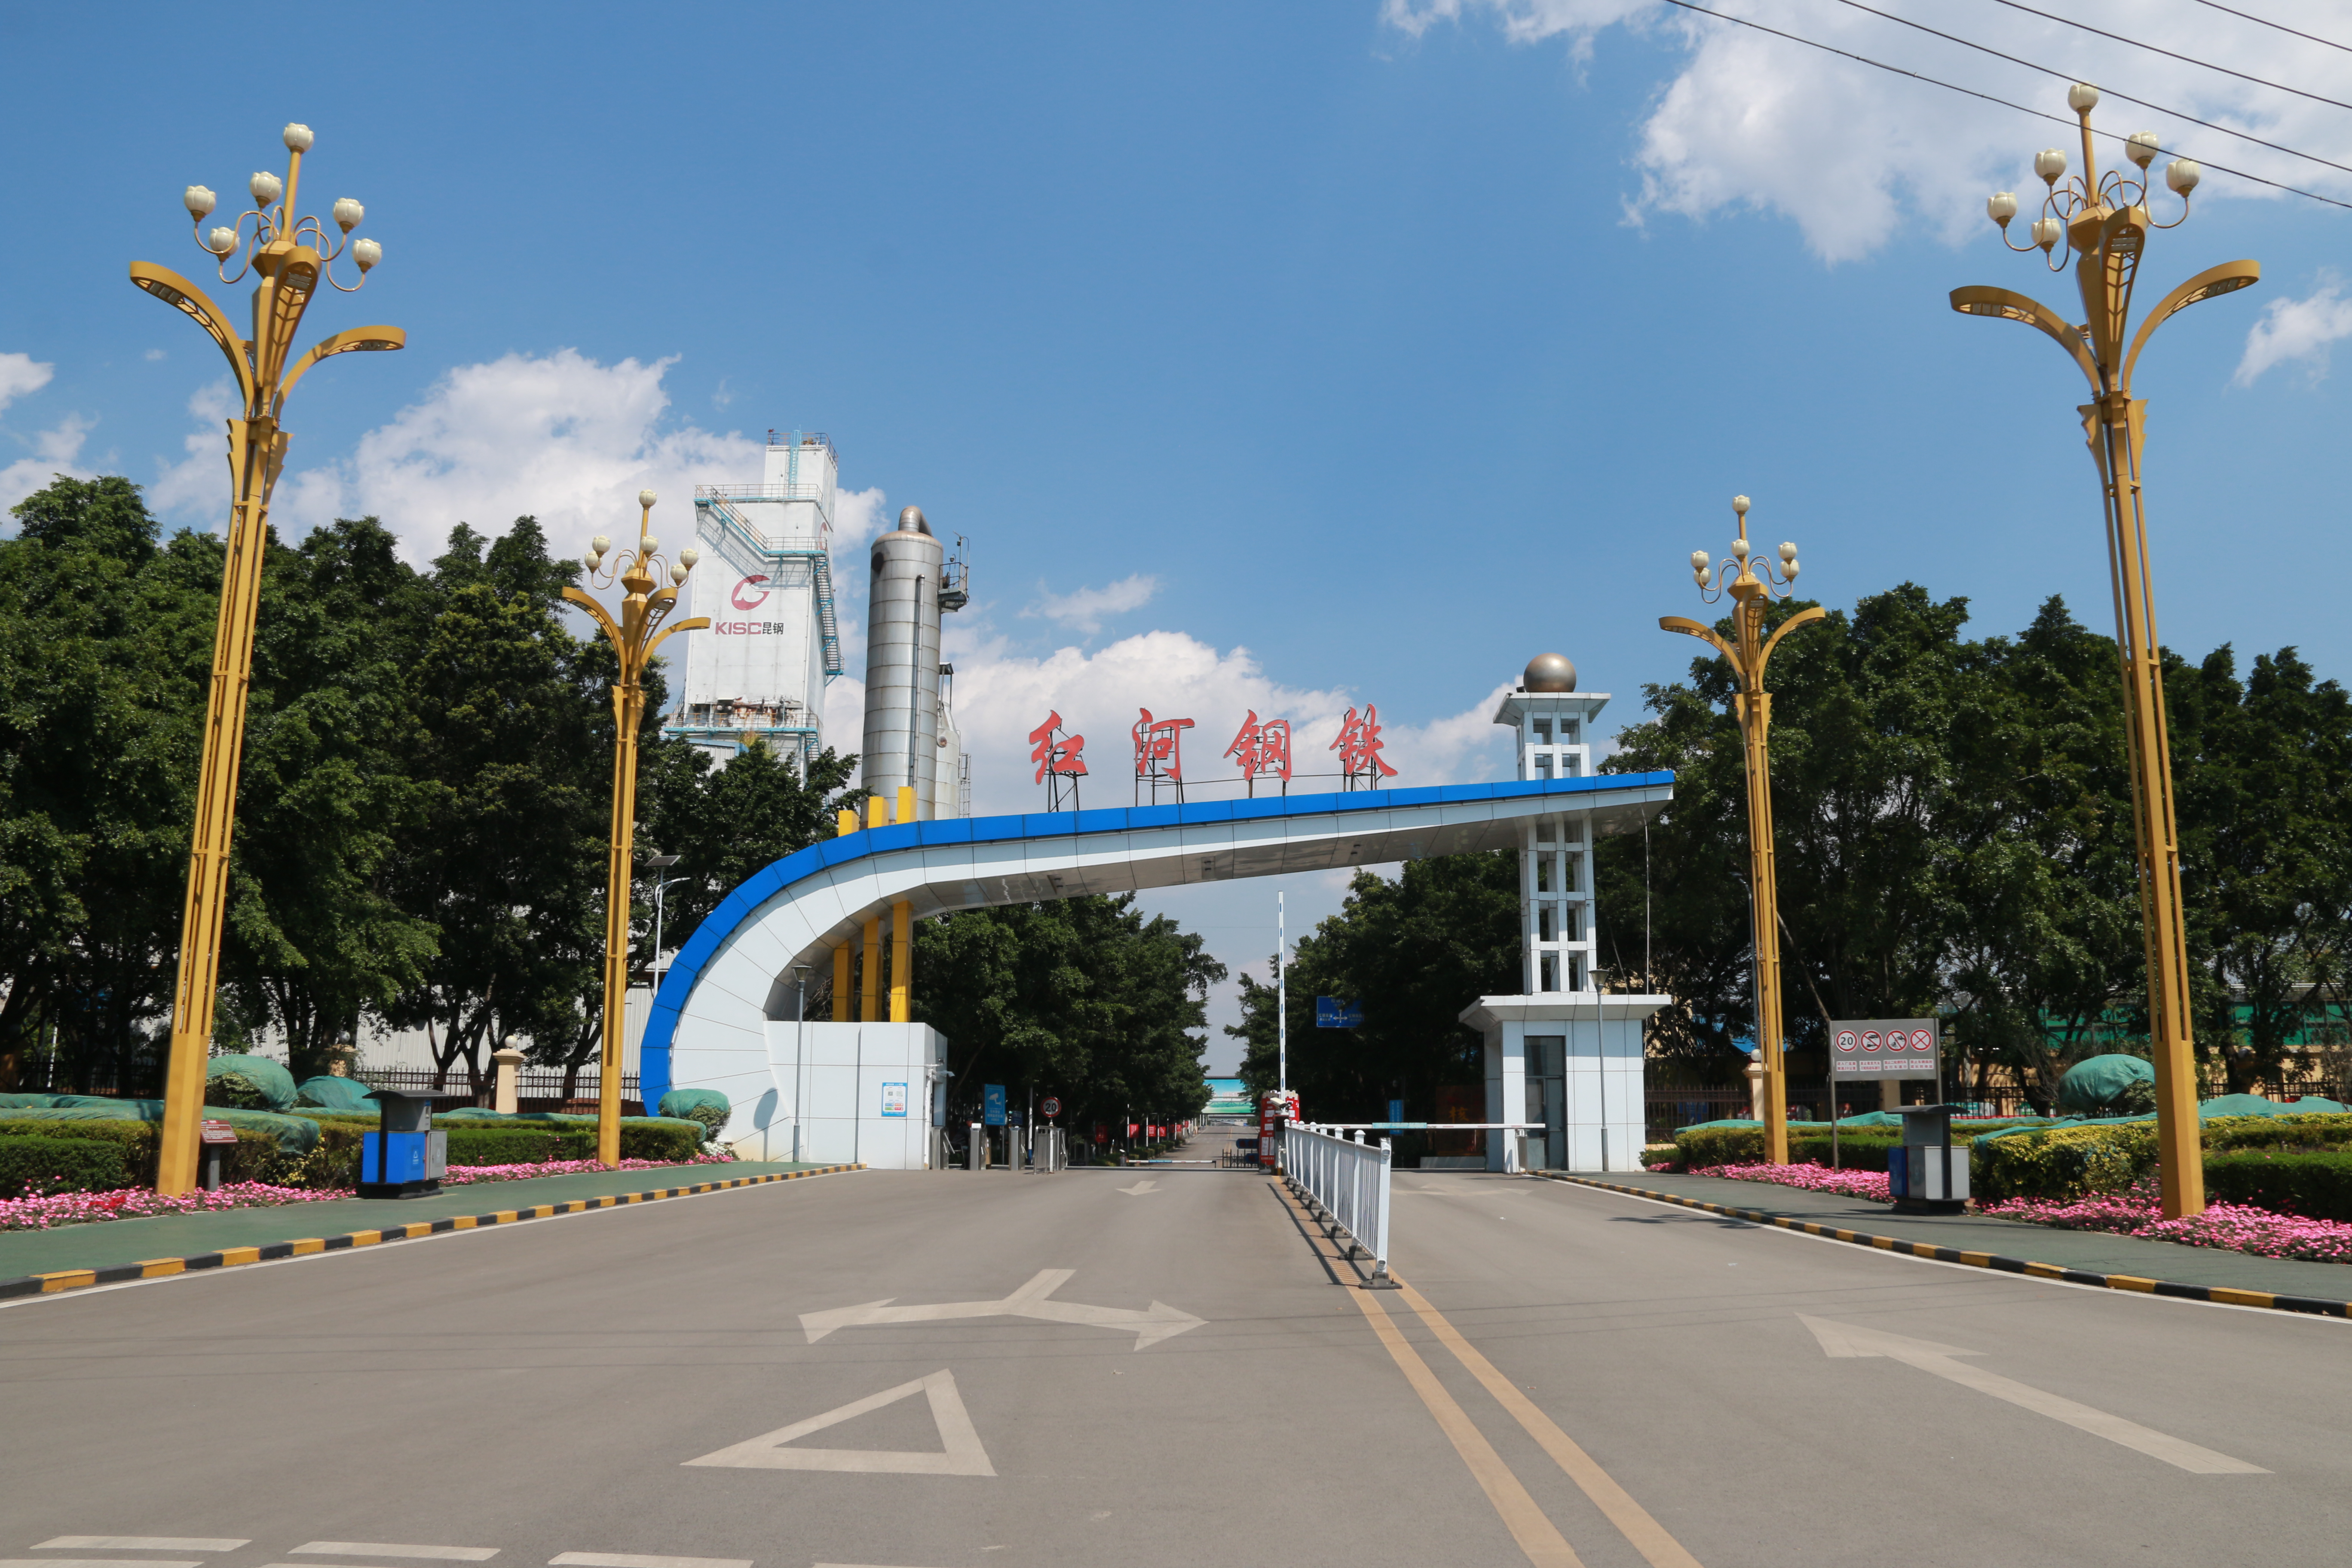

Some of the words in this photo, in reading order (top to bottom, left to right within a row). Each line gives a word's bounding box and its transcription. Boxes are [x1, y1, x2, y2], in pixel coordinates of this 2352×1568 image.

[715, 622, 762, 634] KISC
[763, 622, 784, 634] 昆钢
[1029, 703, 1398, 784] 红河钢铁
[1841, 1037, 1853, 1045] 20
[1045, 1103, 1057, 1112] 20
